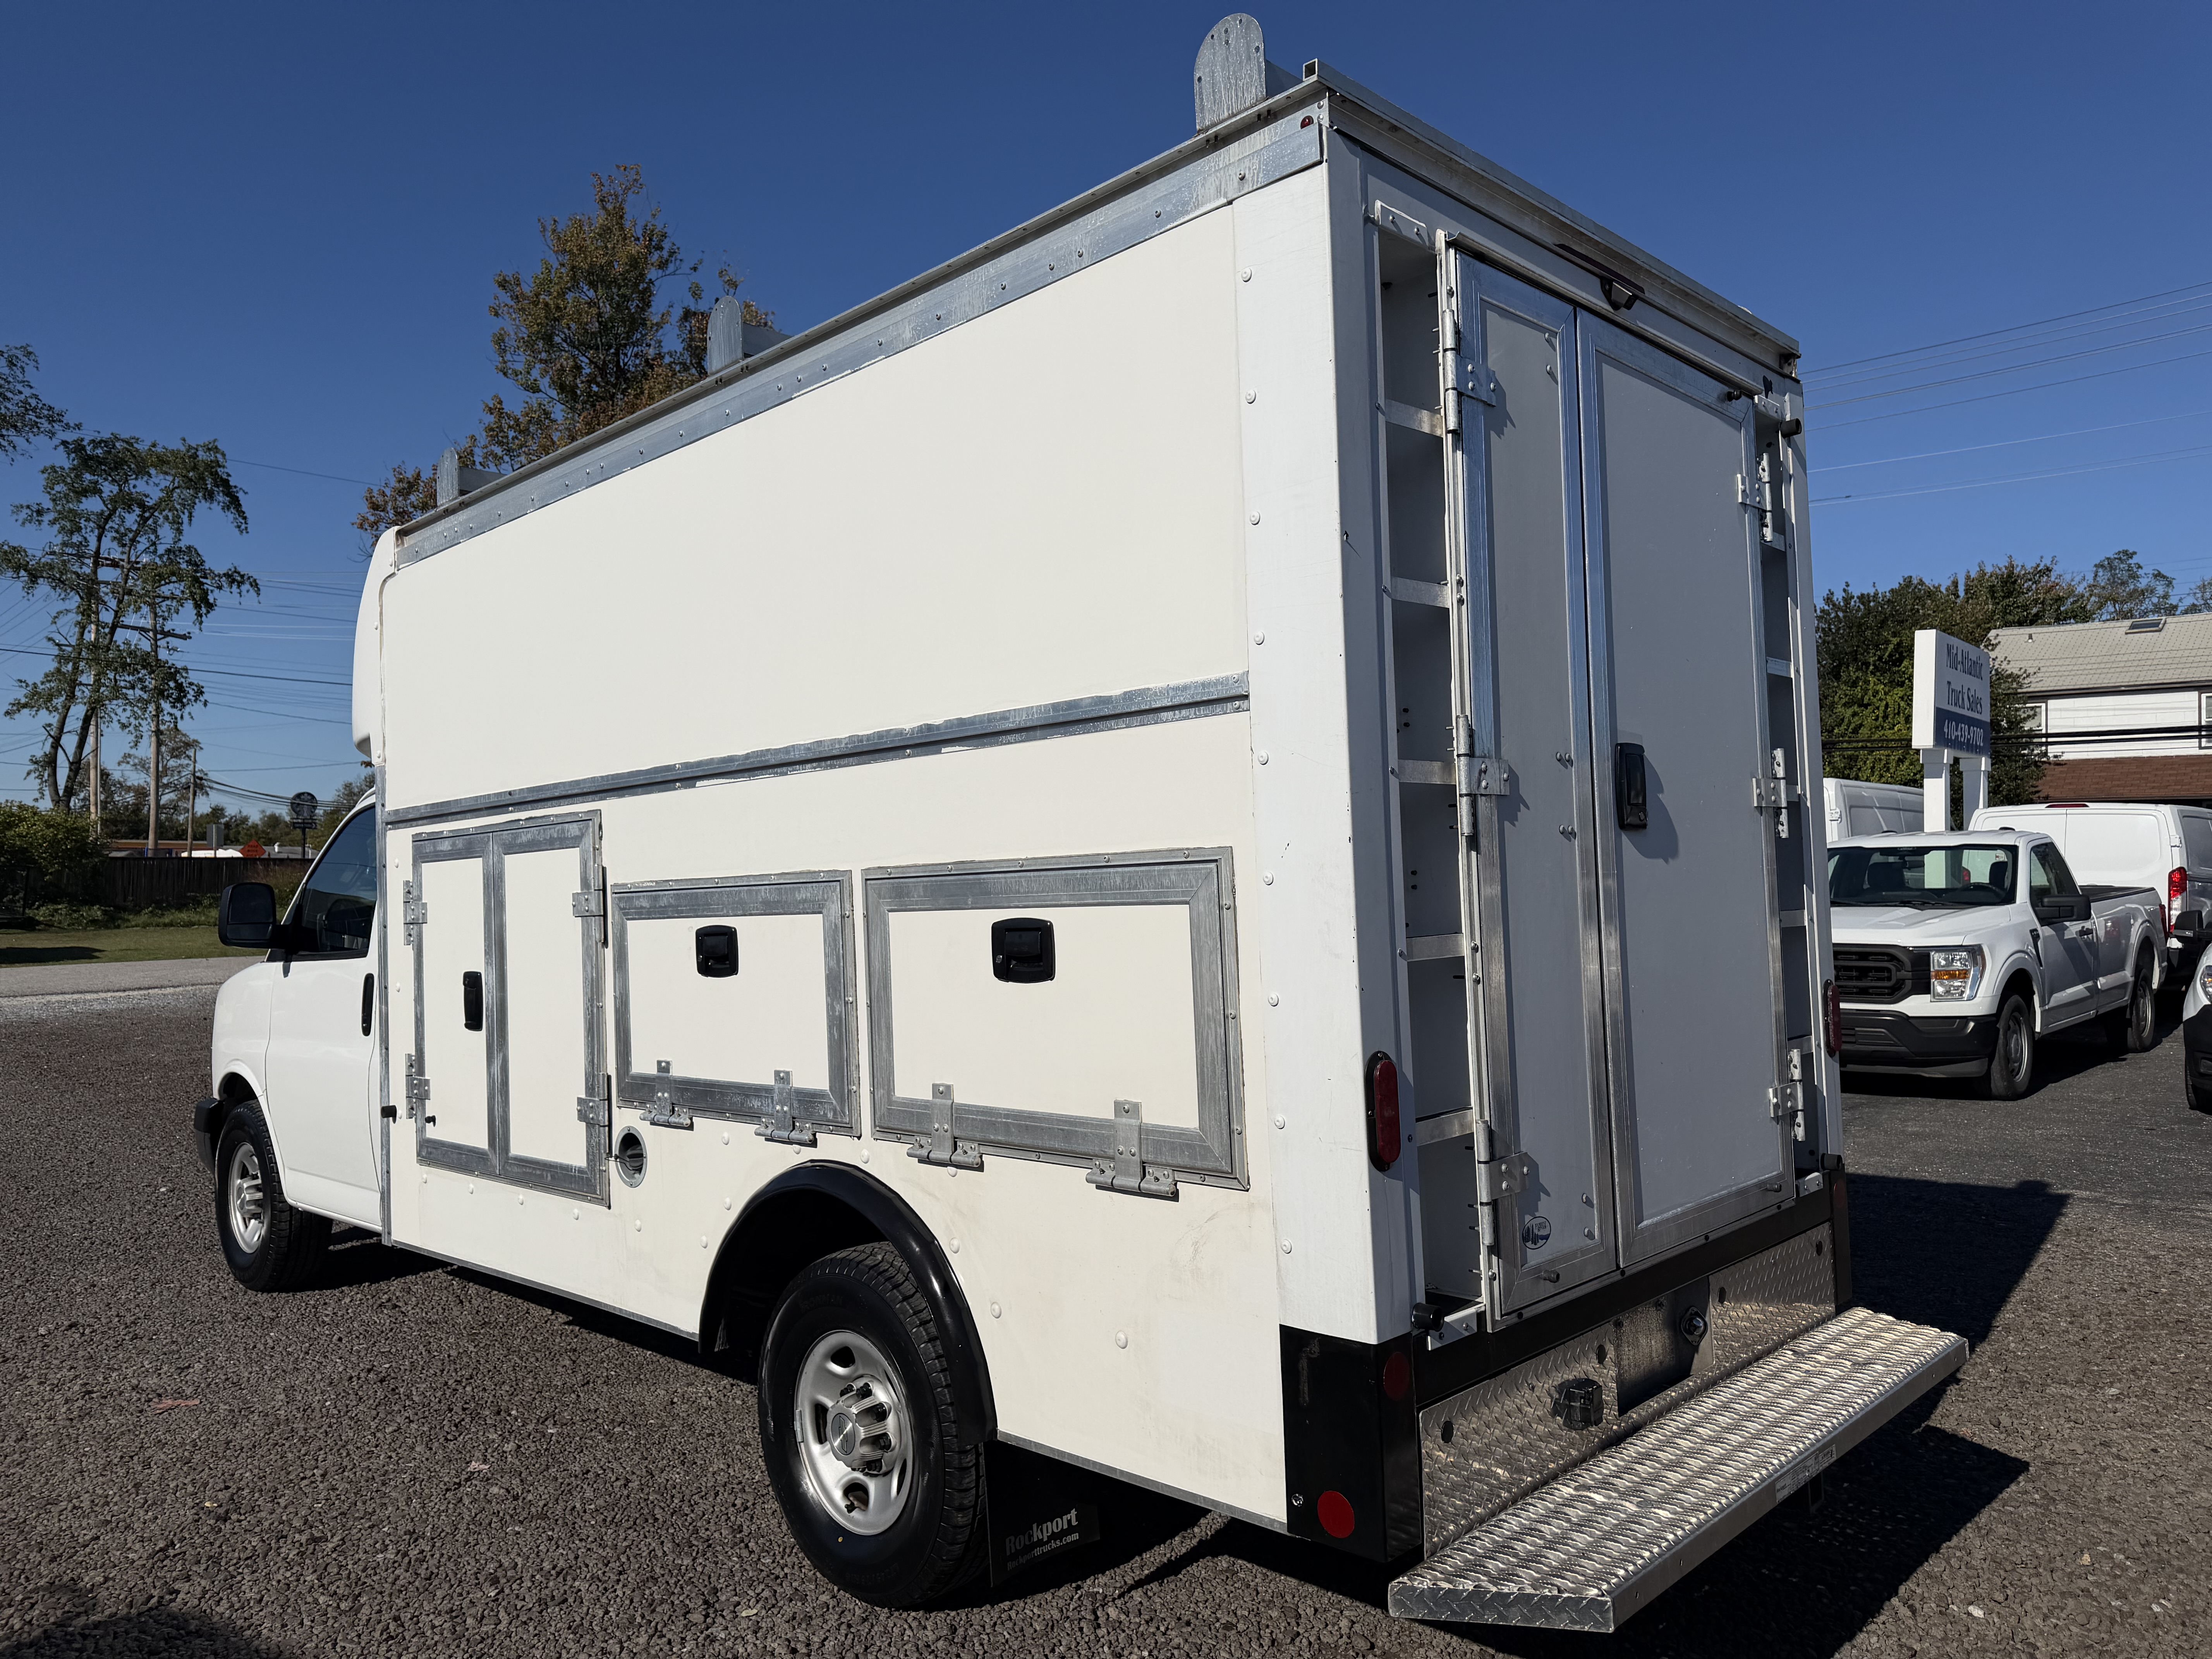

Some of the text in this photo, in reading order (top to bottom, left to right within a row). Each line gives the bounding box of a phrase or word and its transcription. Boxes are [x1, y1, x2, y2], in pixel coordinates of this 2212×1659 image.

[1946, 643, 1983, 681] Mid-Atlantic
[1947, 680, 1983, 715] Truck Sales
[1944, 719, 1984, 746] 410-439-9702
[1005, 1508, 1078, 1556] Rockport
[1007, 1532, 1079, 1571] Rockporttrucks.com
